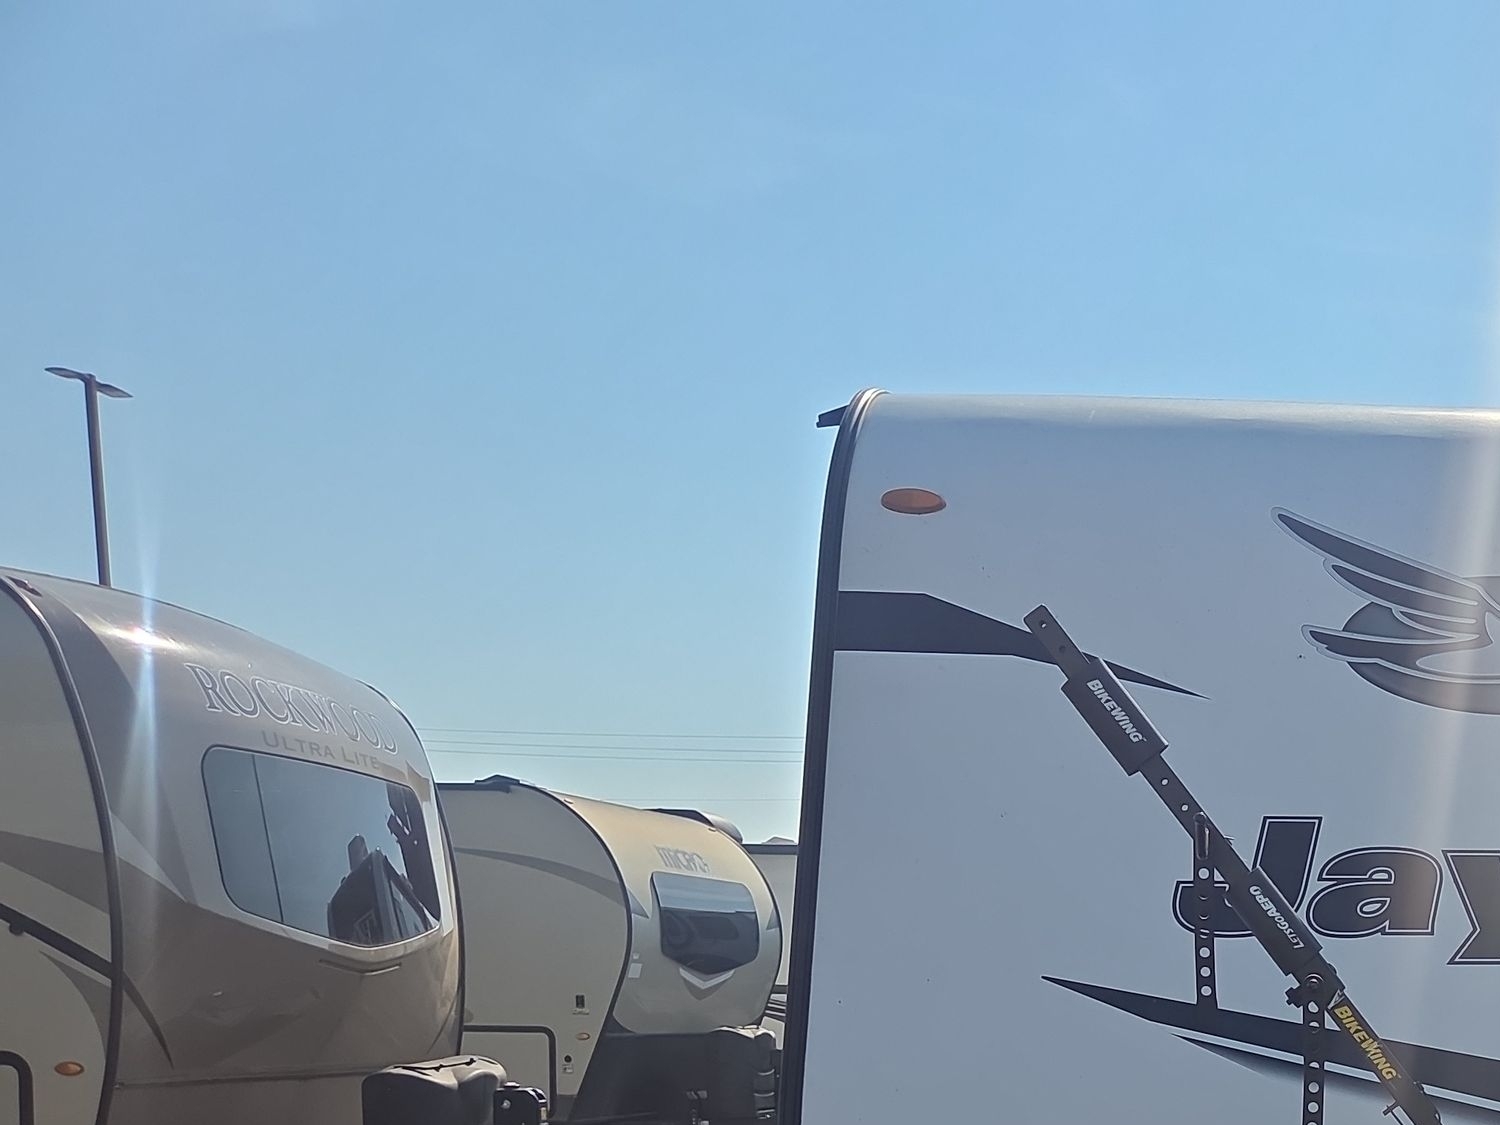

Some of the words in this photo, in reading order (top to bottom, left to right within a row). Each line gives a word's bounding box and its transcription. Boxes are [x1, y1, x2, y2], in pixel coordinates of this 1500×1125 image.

[184, 663, 397, 755] ROCKWOOD
[1086, 679, 1142, 743] BIKEWING
[261, 730, 335, 760] ULTRA
[341, 750, 380, 770] LITE
[1333, 1005, 1397, 1080] BIKEWING
